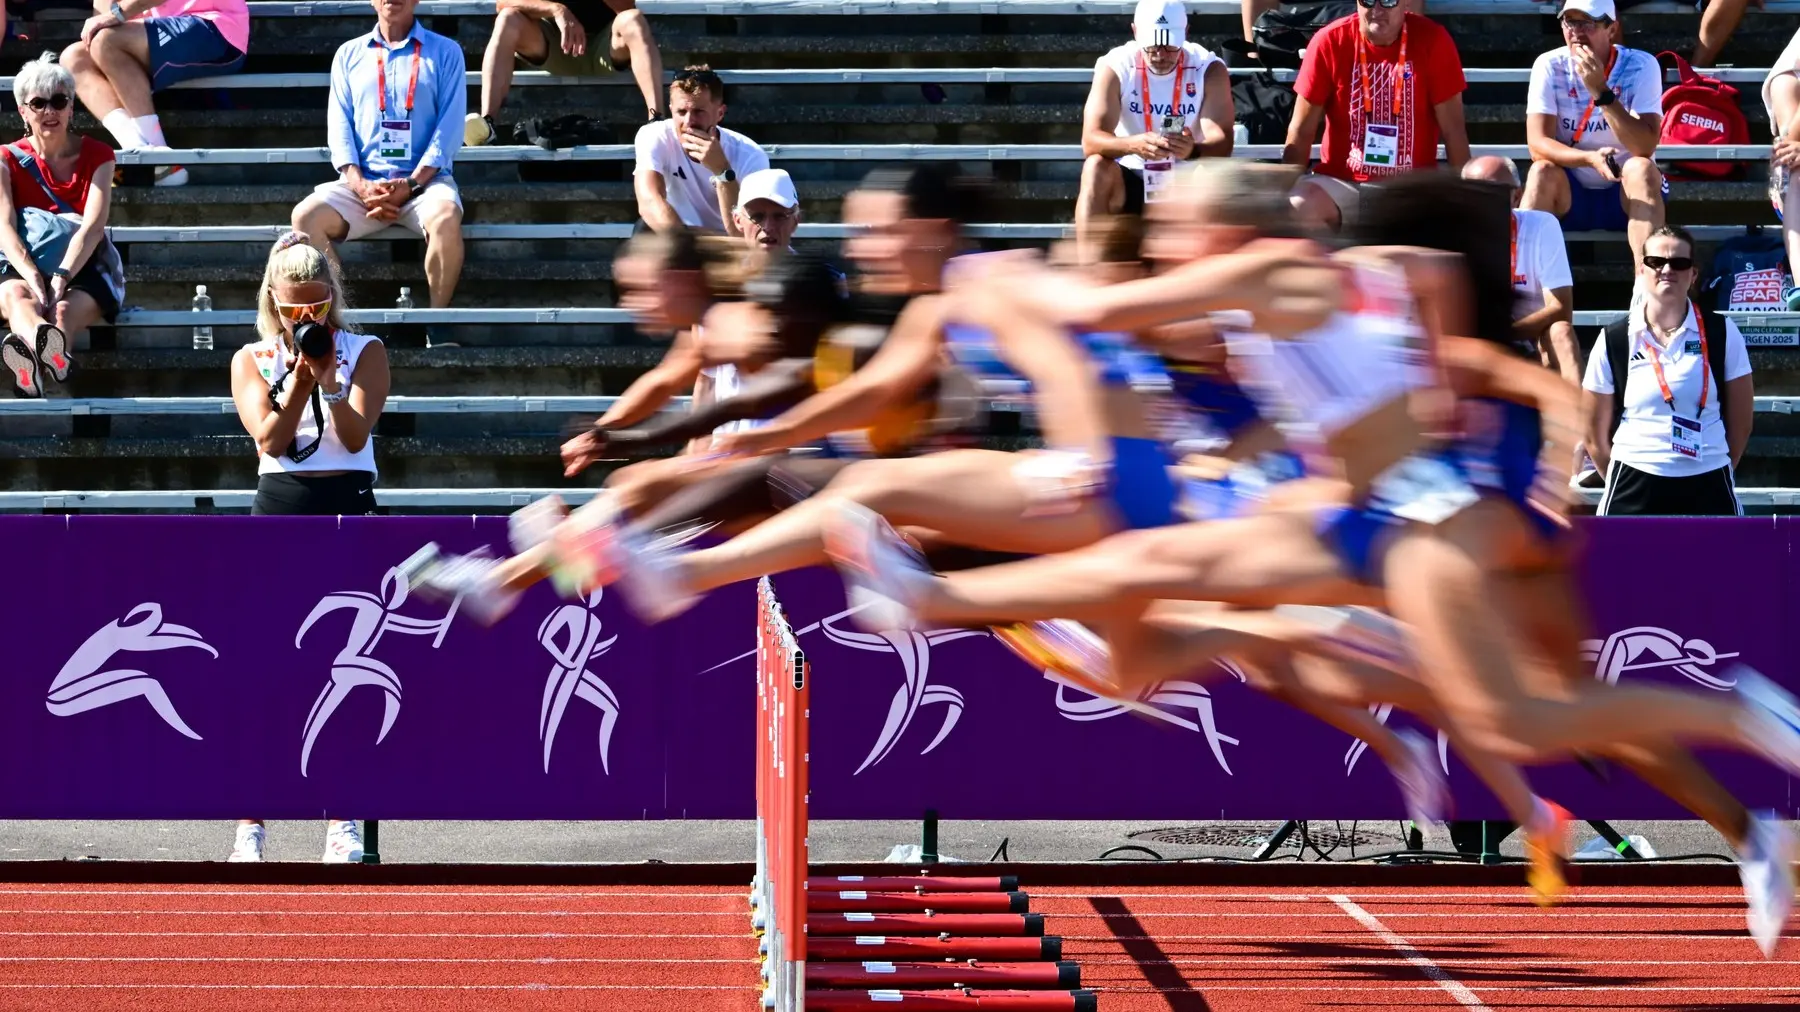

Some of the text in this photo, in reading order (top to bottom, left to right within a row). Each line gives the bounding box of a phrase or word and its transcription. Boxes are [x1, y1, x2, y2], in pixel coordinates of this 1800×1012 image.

[1681, 113, 1724, 133] SERBIA
[1733, 289, 1779, 301] SPAR
[1743, 335, 1794, 344] RGEN 2025
